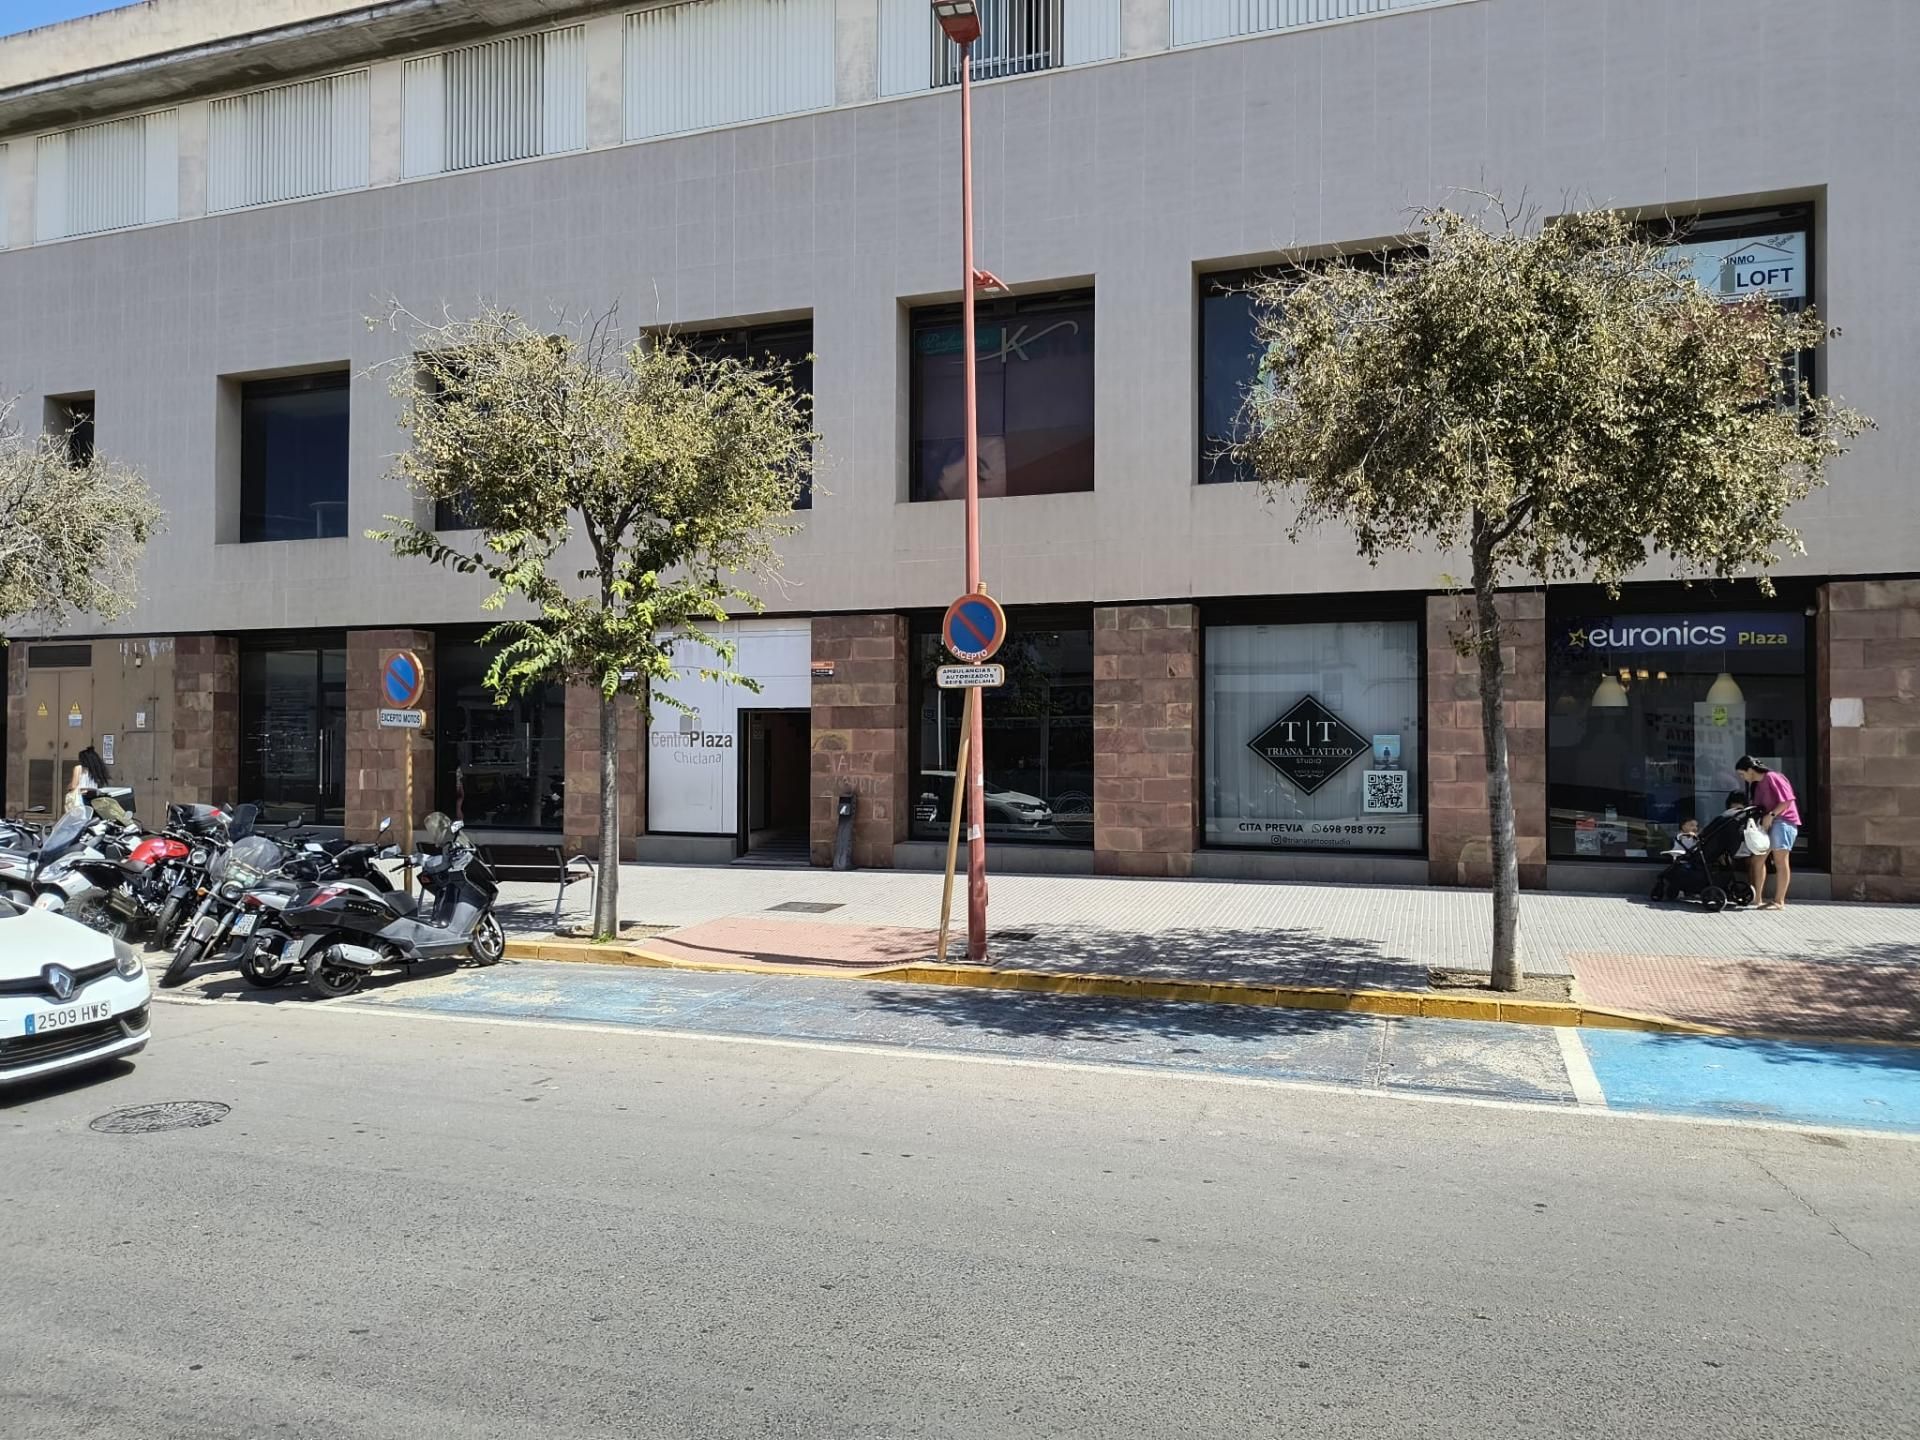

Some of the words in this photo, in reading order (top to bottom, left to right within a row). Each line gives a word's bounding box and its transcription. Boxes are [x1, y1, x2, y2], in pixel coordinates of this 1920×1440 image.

[1726, 255, 1755, 265] INMO
[1736, 267, 1794, 288] LOFT
[1588, 620, 1727, 648] euronics
[1738, 632, 1788, 645] Plaza
[951, 645, 988, 660] EXCEPTO
[381, 712, 402, 723] EXCEPTO
[403, 713, 420, 724] MOTOS
[673, 751, 722, 765] Chiclana
[1264, 748, 1304, 756] TRIANA
[1309, 748, 1353, 756] TATTOO
[1238, 823, 1262, 832] CITA
[1265, 823, 1304, 833] PREVIA
[1322, 825, 1342, 834] 698
[1344, 825, 1364, 835] 988
[1366, 826, 1387, 835] 972
[38, 1009, 77, 1031] 2509
[81, 1003, 109, 1021] HWS
